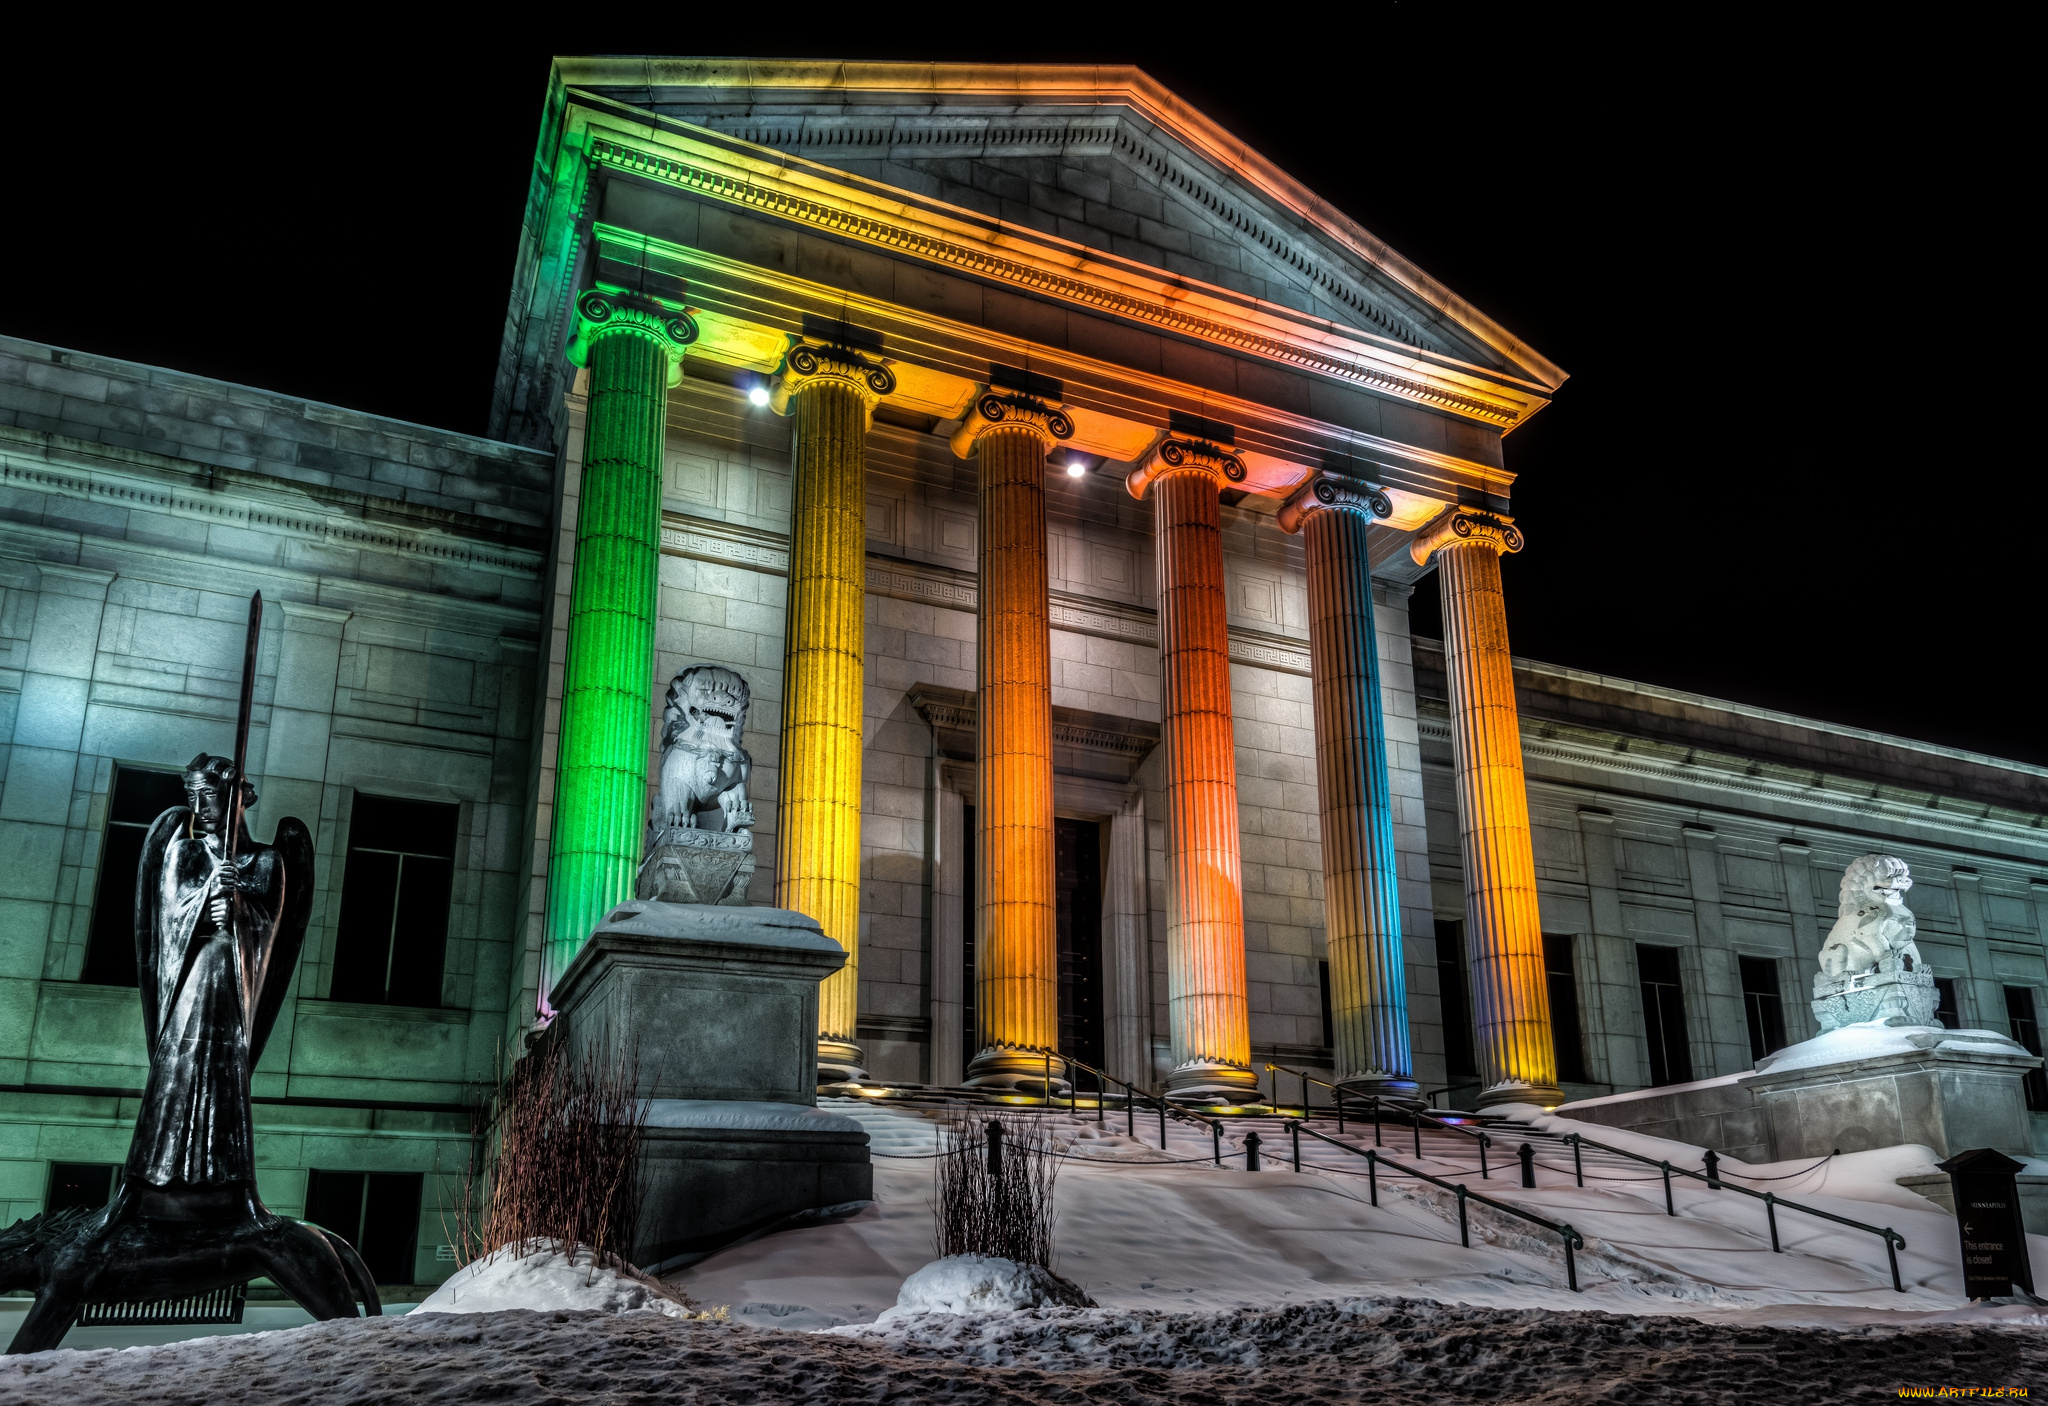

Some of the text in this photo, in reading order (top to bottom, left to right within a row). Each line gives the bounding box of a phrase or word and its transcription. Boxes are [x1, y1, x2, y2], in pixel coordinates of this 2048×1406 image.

[1964, 1240, 2003, 1251] This entrance
[1966, 1254, 1992, 1264] is closed
